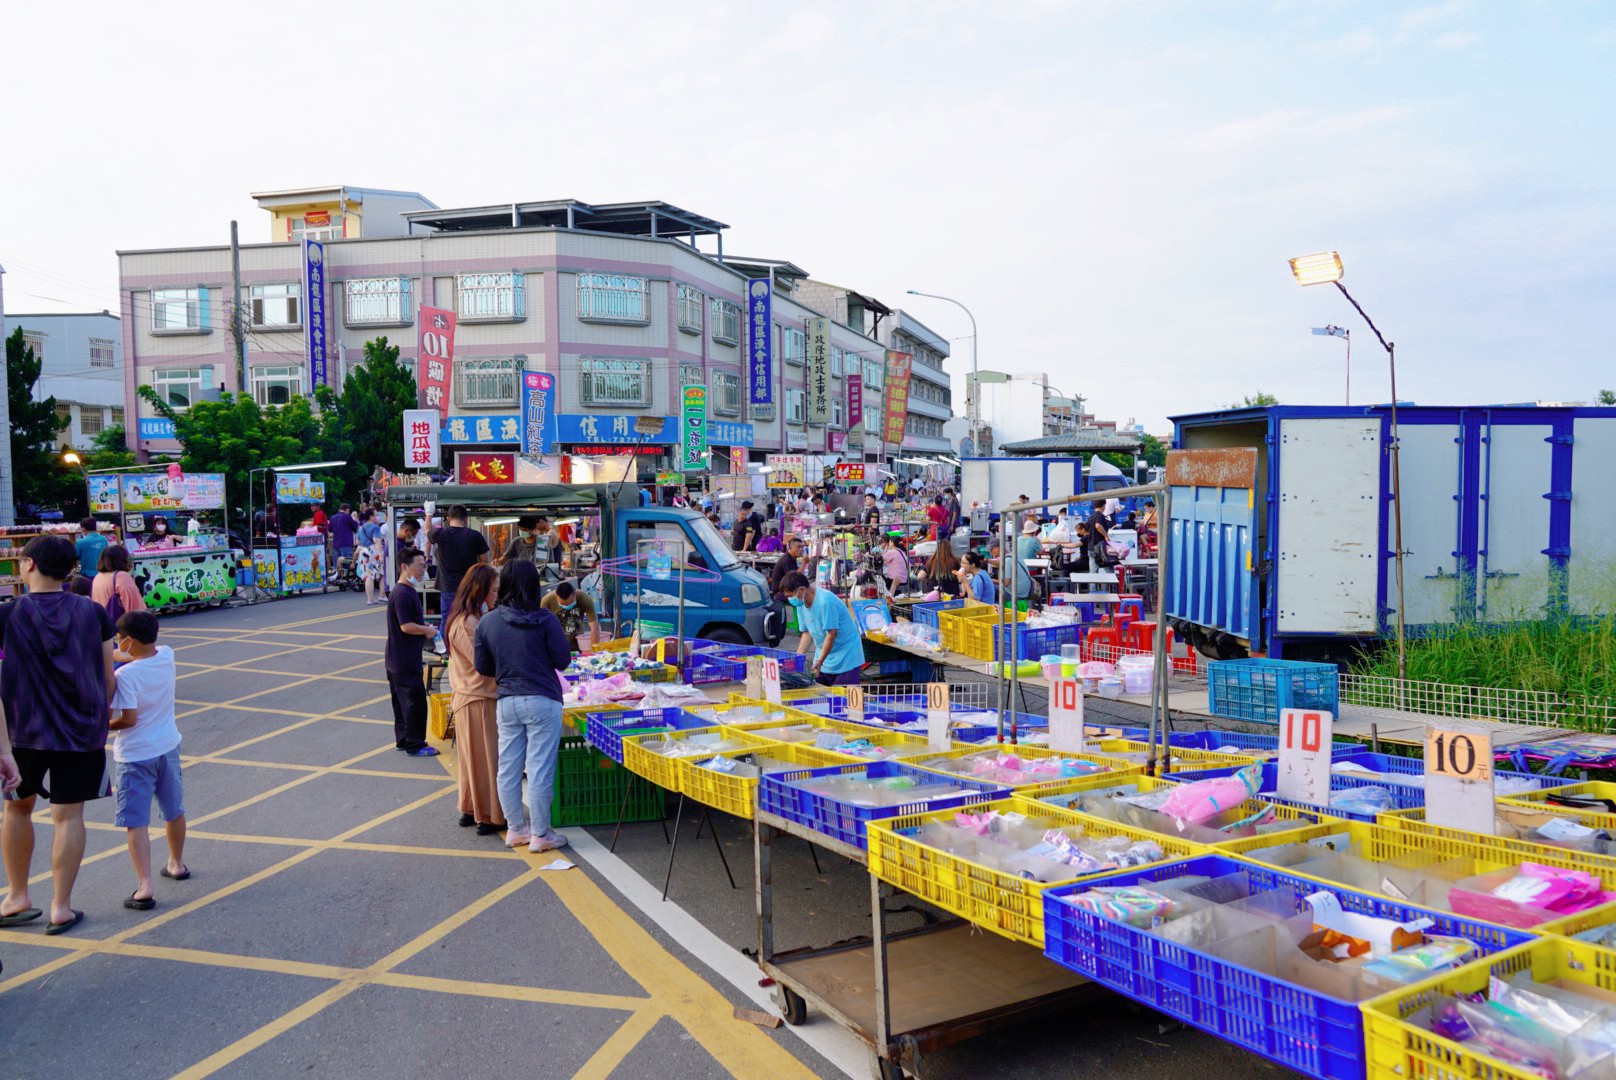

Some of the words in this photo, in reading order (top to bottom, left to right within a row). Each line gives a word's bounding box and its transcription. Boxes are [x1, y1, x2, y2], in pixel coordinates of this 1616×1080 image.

[754, 300, 767, 400] 南龍區漁會信用部
[527, 389, 546, 454] 高山紅茶
[411, 422, 431, 464] 地瓜球
[766, 662, 777, 681] 10
[847, 687, 859, 709] 10
[929, 685, 943, 709] 10
[1055, 681, 1076, 710] 10
[1287, 713, 1321, 753] 10
